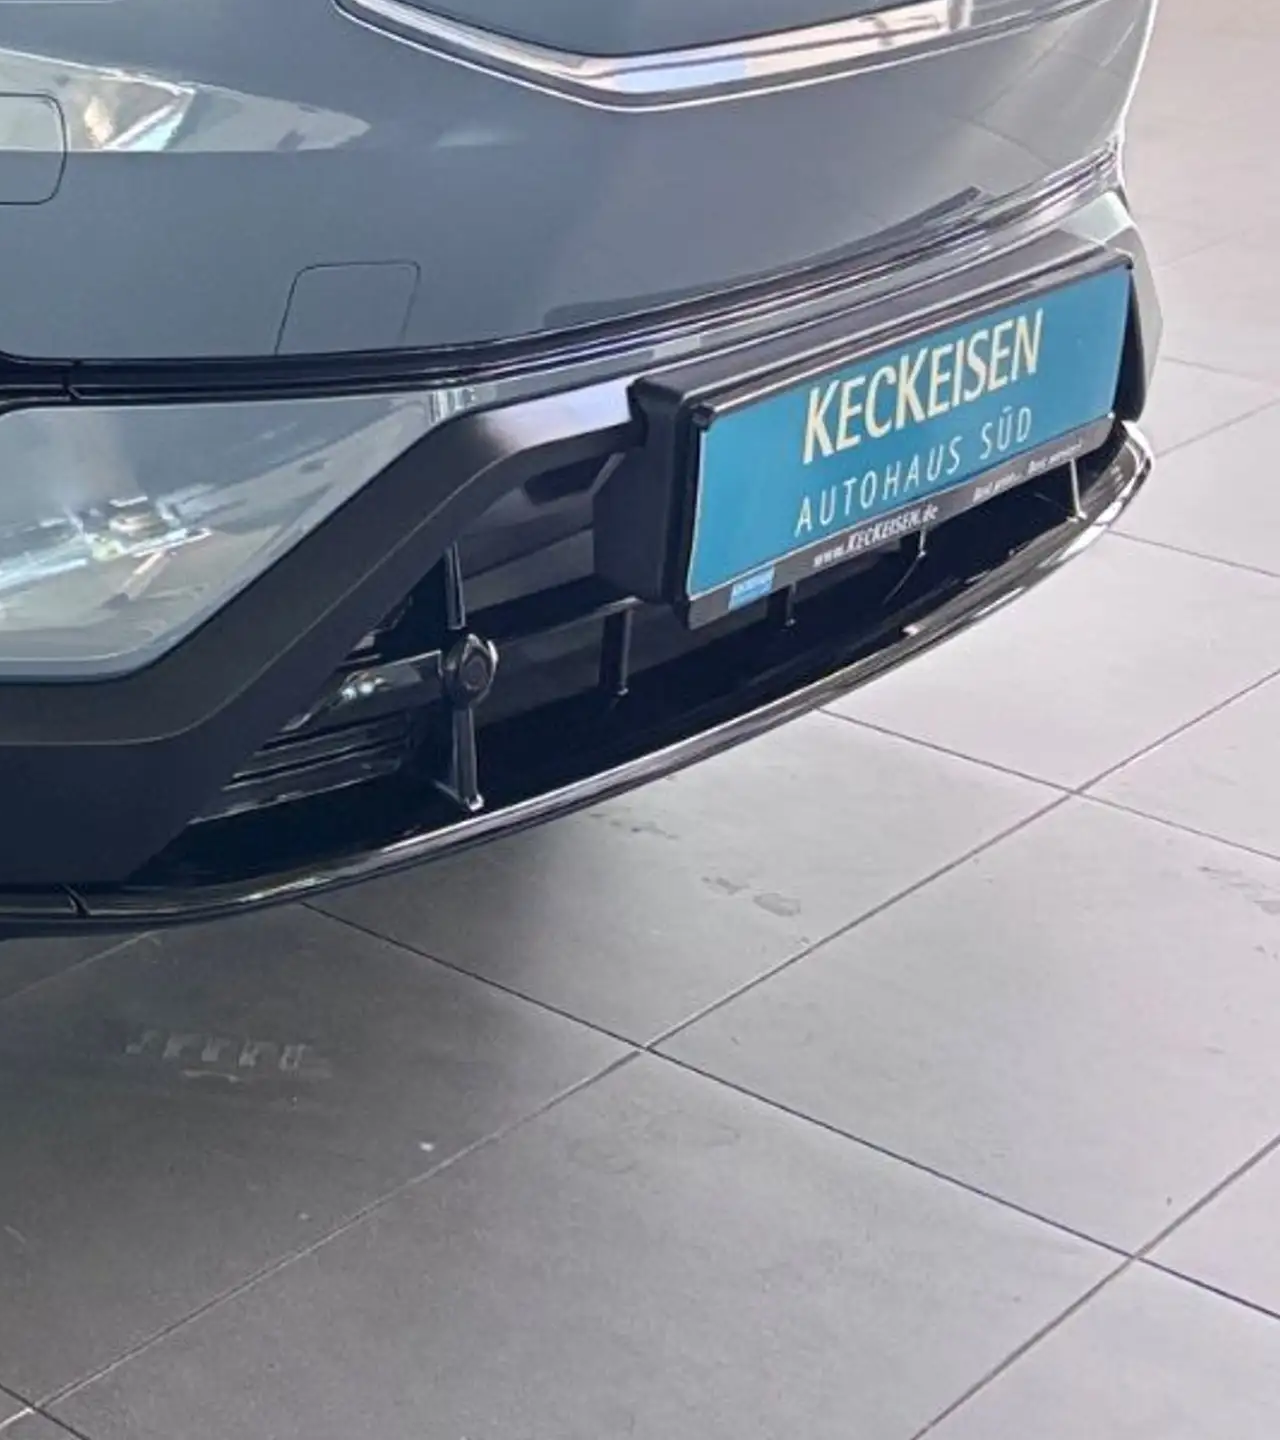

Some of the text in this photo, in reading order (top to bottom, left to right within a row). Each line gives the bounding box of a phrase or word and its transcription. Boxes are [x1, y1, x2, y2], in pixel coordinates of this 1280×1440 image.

[802, 307, 1044, 464] KECKEISEN
[794, 435, 963, 539] AUTOHAUS
[979, 405, 1033, 461] SÜD
[812, 502, 939, 568] www.KECKEISEN.de
